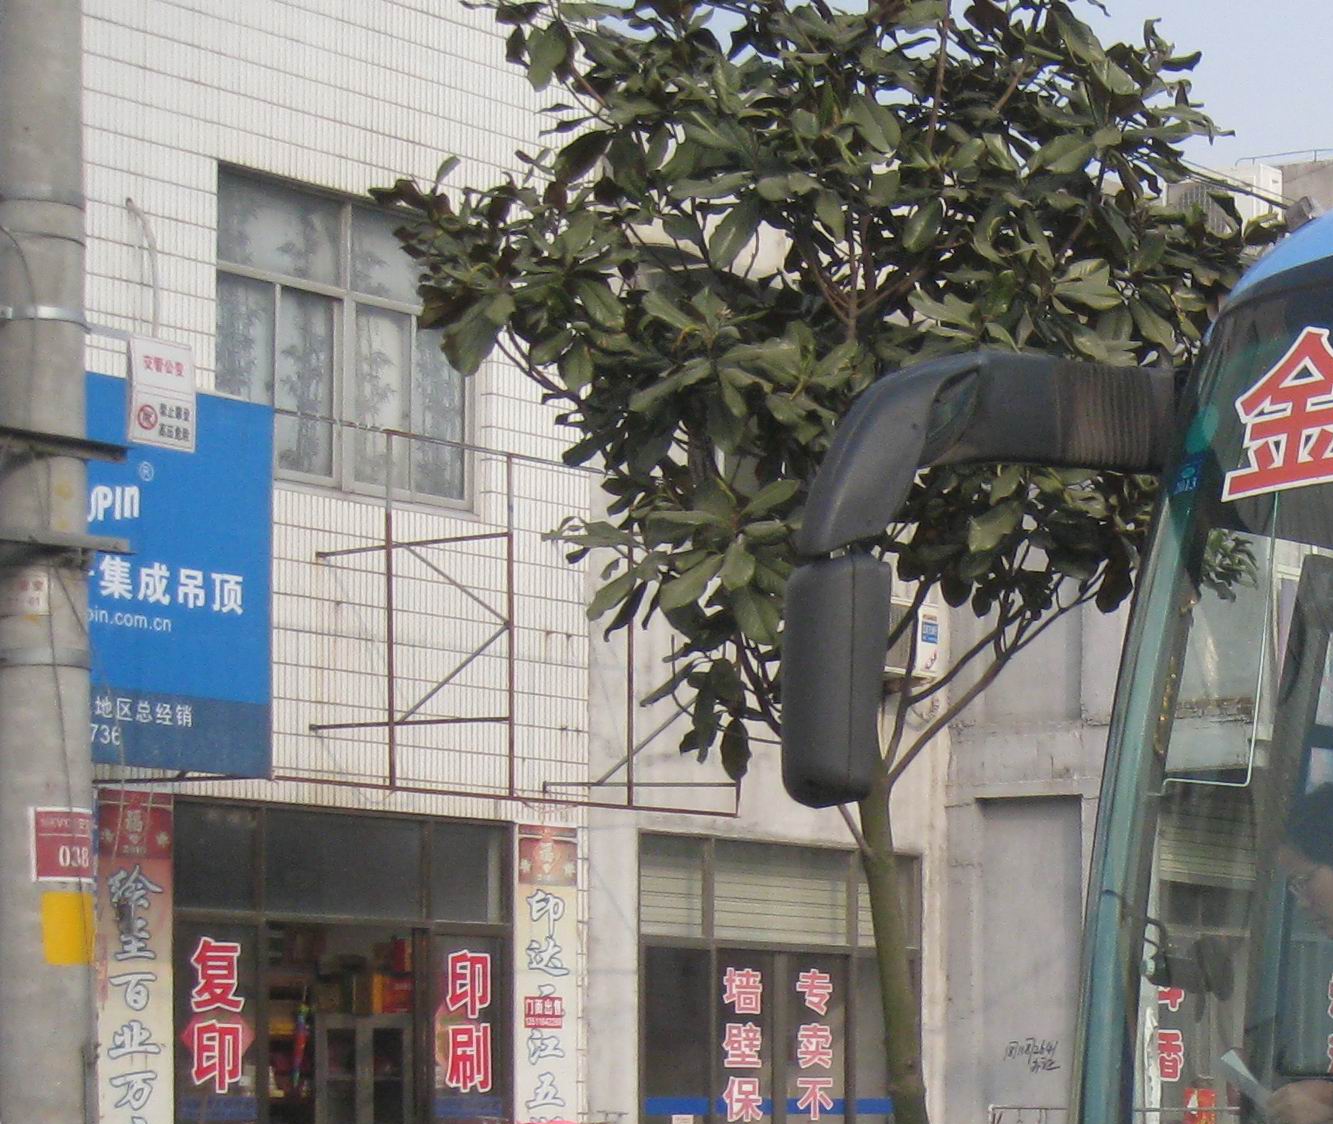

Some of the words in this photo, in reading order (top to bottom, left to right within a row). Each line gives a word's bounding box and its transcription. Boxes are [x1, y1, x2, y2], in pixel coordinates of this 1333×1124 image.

[88, 555, 244, 615] 集成吊顶
[95, 696, 193, 728] 地区总经销
[191, 937, 245, 1093] 复印
[446, 949, 492, 1093] 印刷
